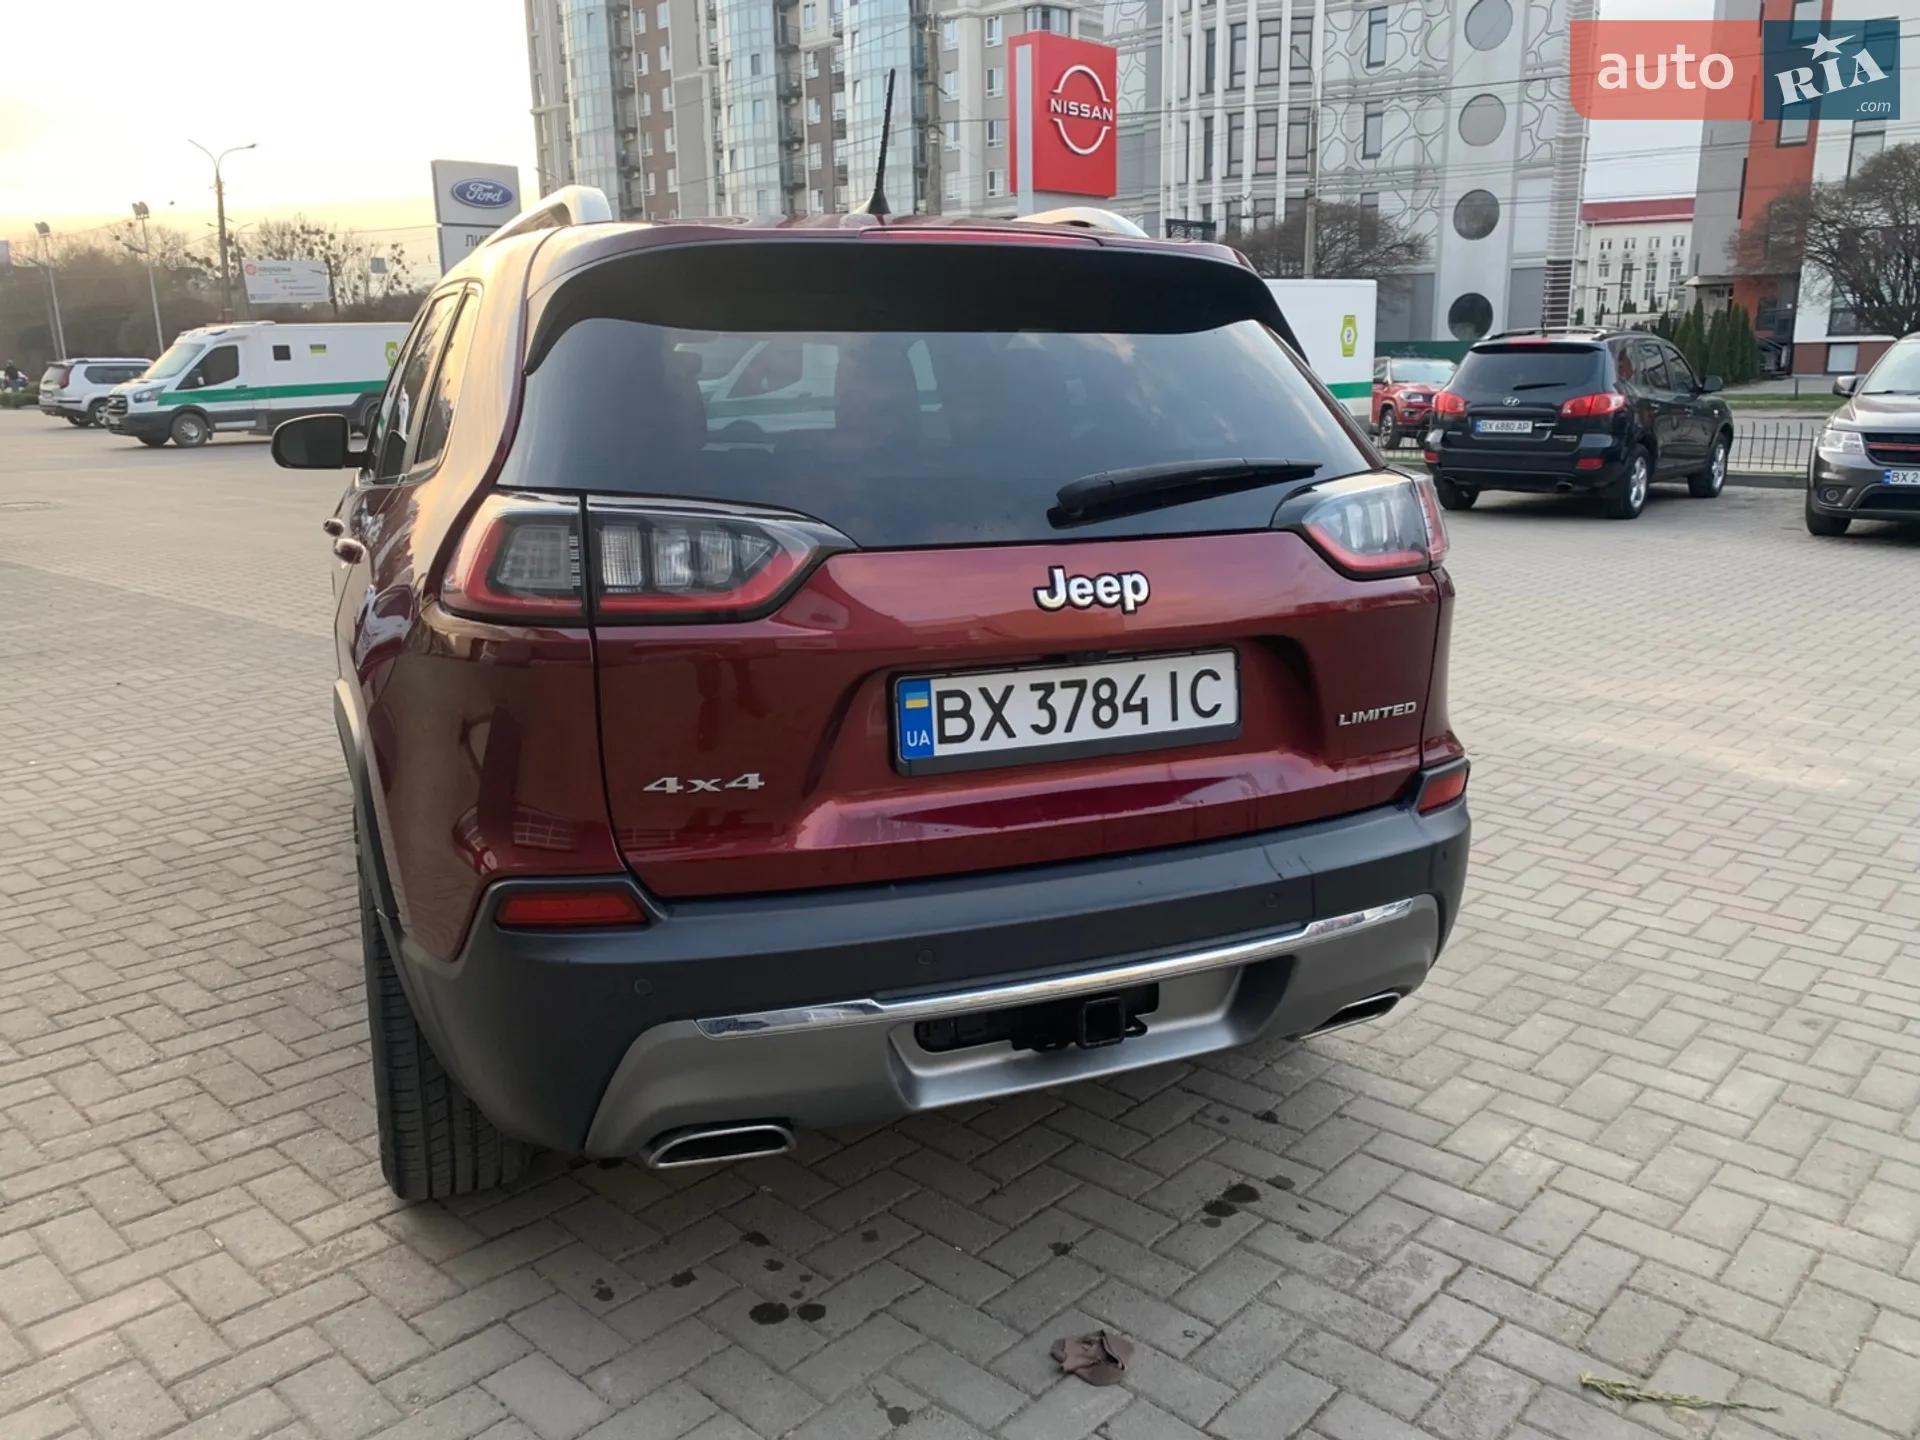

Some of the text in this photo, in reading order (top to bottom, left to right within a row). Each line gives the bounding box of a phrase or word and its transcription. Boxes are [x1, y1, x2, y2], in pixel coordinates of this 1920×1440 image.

[1050, 98, 1113, 122] NISSAN
[465, 183, 503, 202] Ford
[1891, 471, 1909, 483] BX
[1035, 566, 1150, 613] Jeep
[935, 668, 1222, 745] BX 3784 IC
[1338, 701, 1417, 727] LIMITED
[906, 729, 931, 747] UA
[642, 772, 766, 794] 4x4
